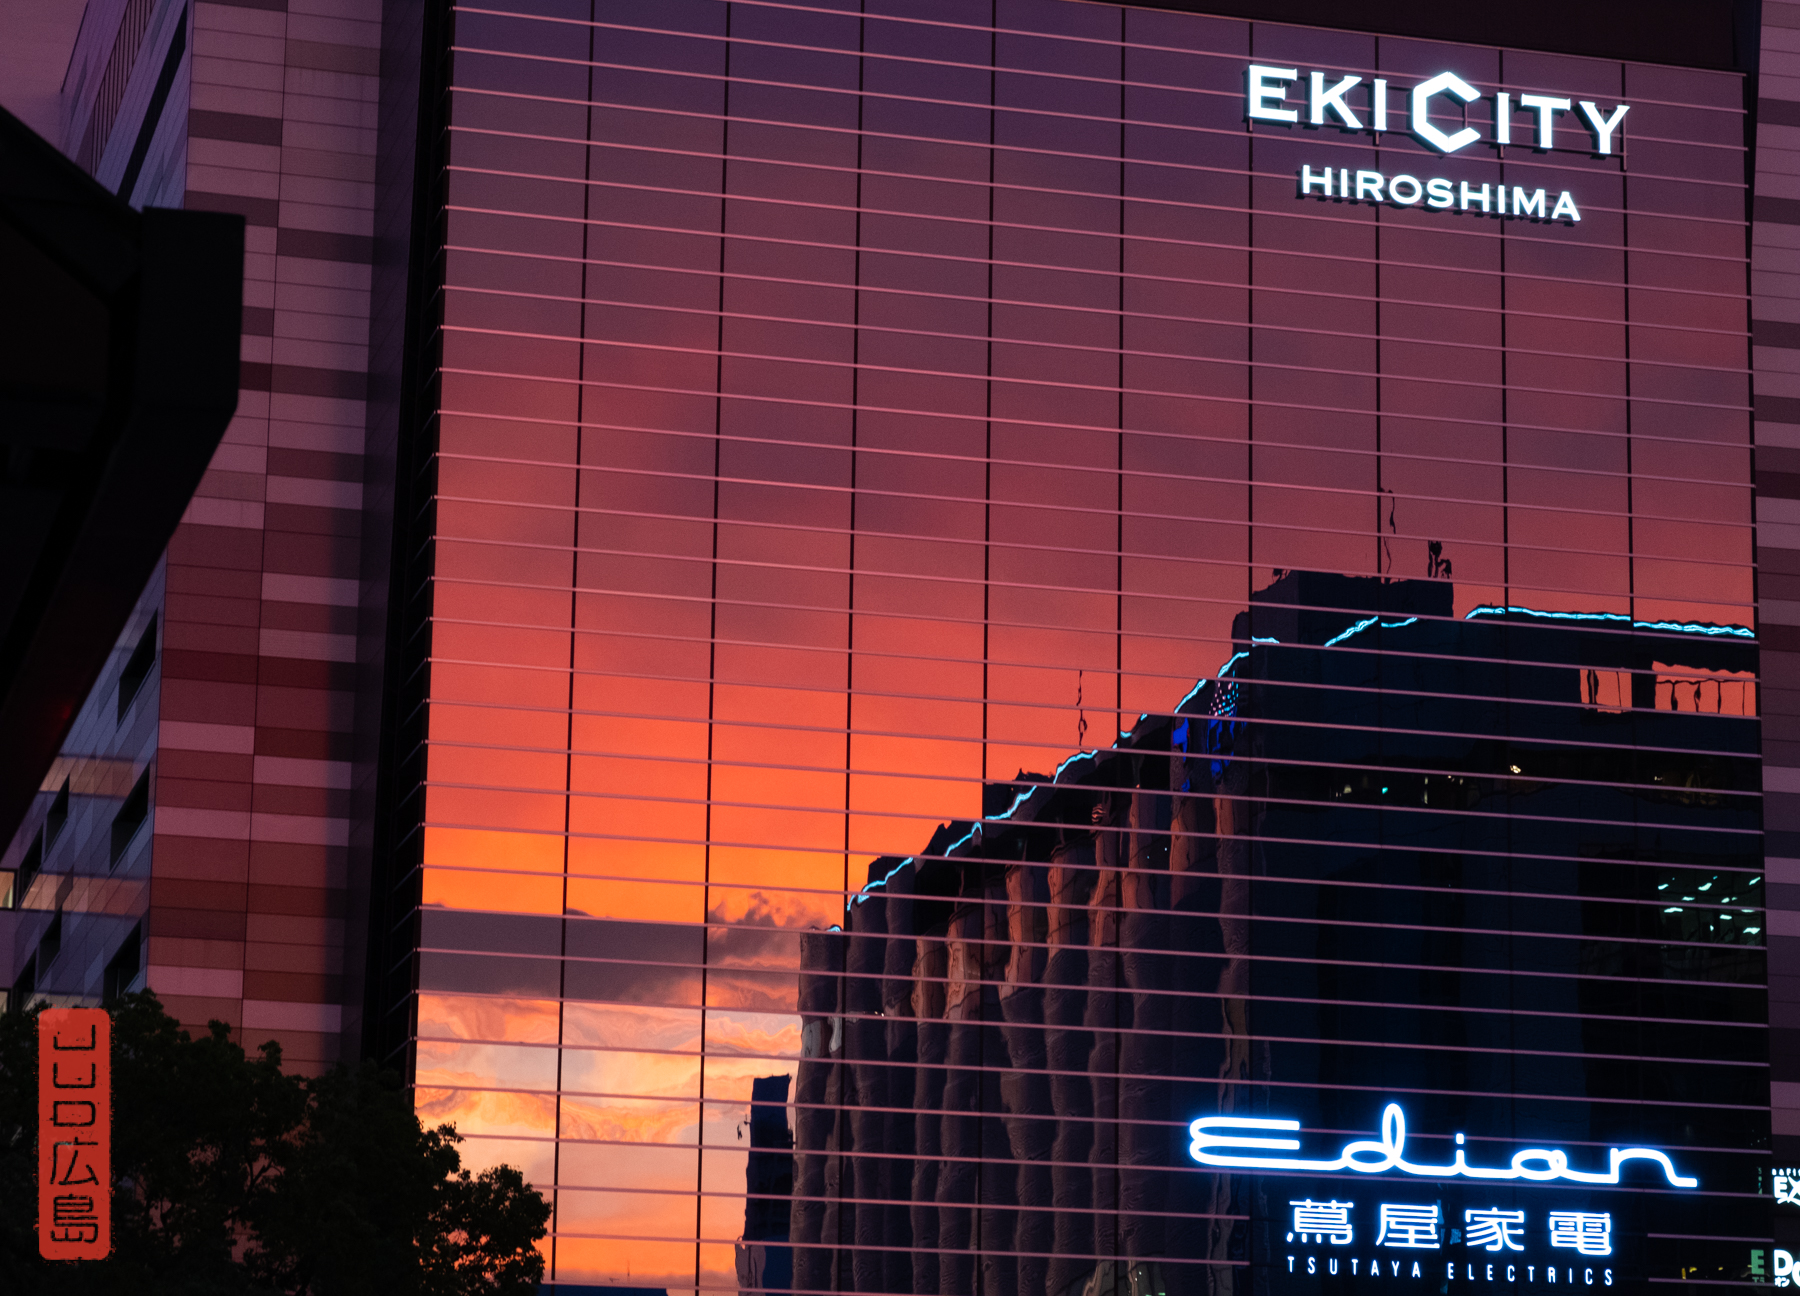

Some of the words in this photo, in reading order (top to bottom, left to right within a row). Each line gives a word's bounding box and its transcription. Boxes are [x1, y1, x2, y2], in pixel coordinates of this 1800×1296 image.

[1249, 65, 1387, 130] EKI
[1412, 71, 1630, 154] CITY
[1302, 165, 1581, 221] HIROSHIMA
[1286, 1199, 1612, 1256] 蔦屋家電
[1287, 1256, 1421, 1278] TSUTAYA
[1447, 1262, 1613, 1286] ELECTRICS
